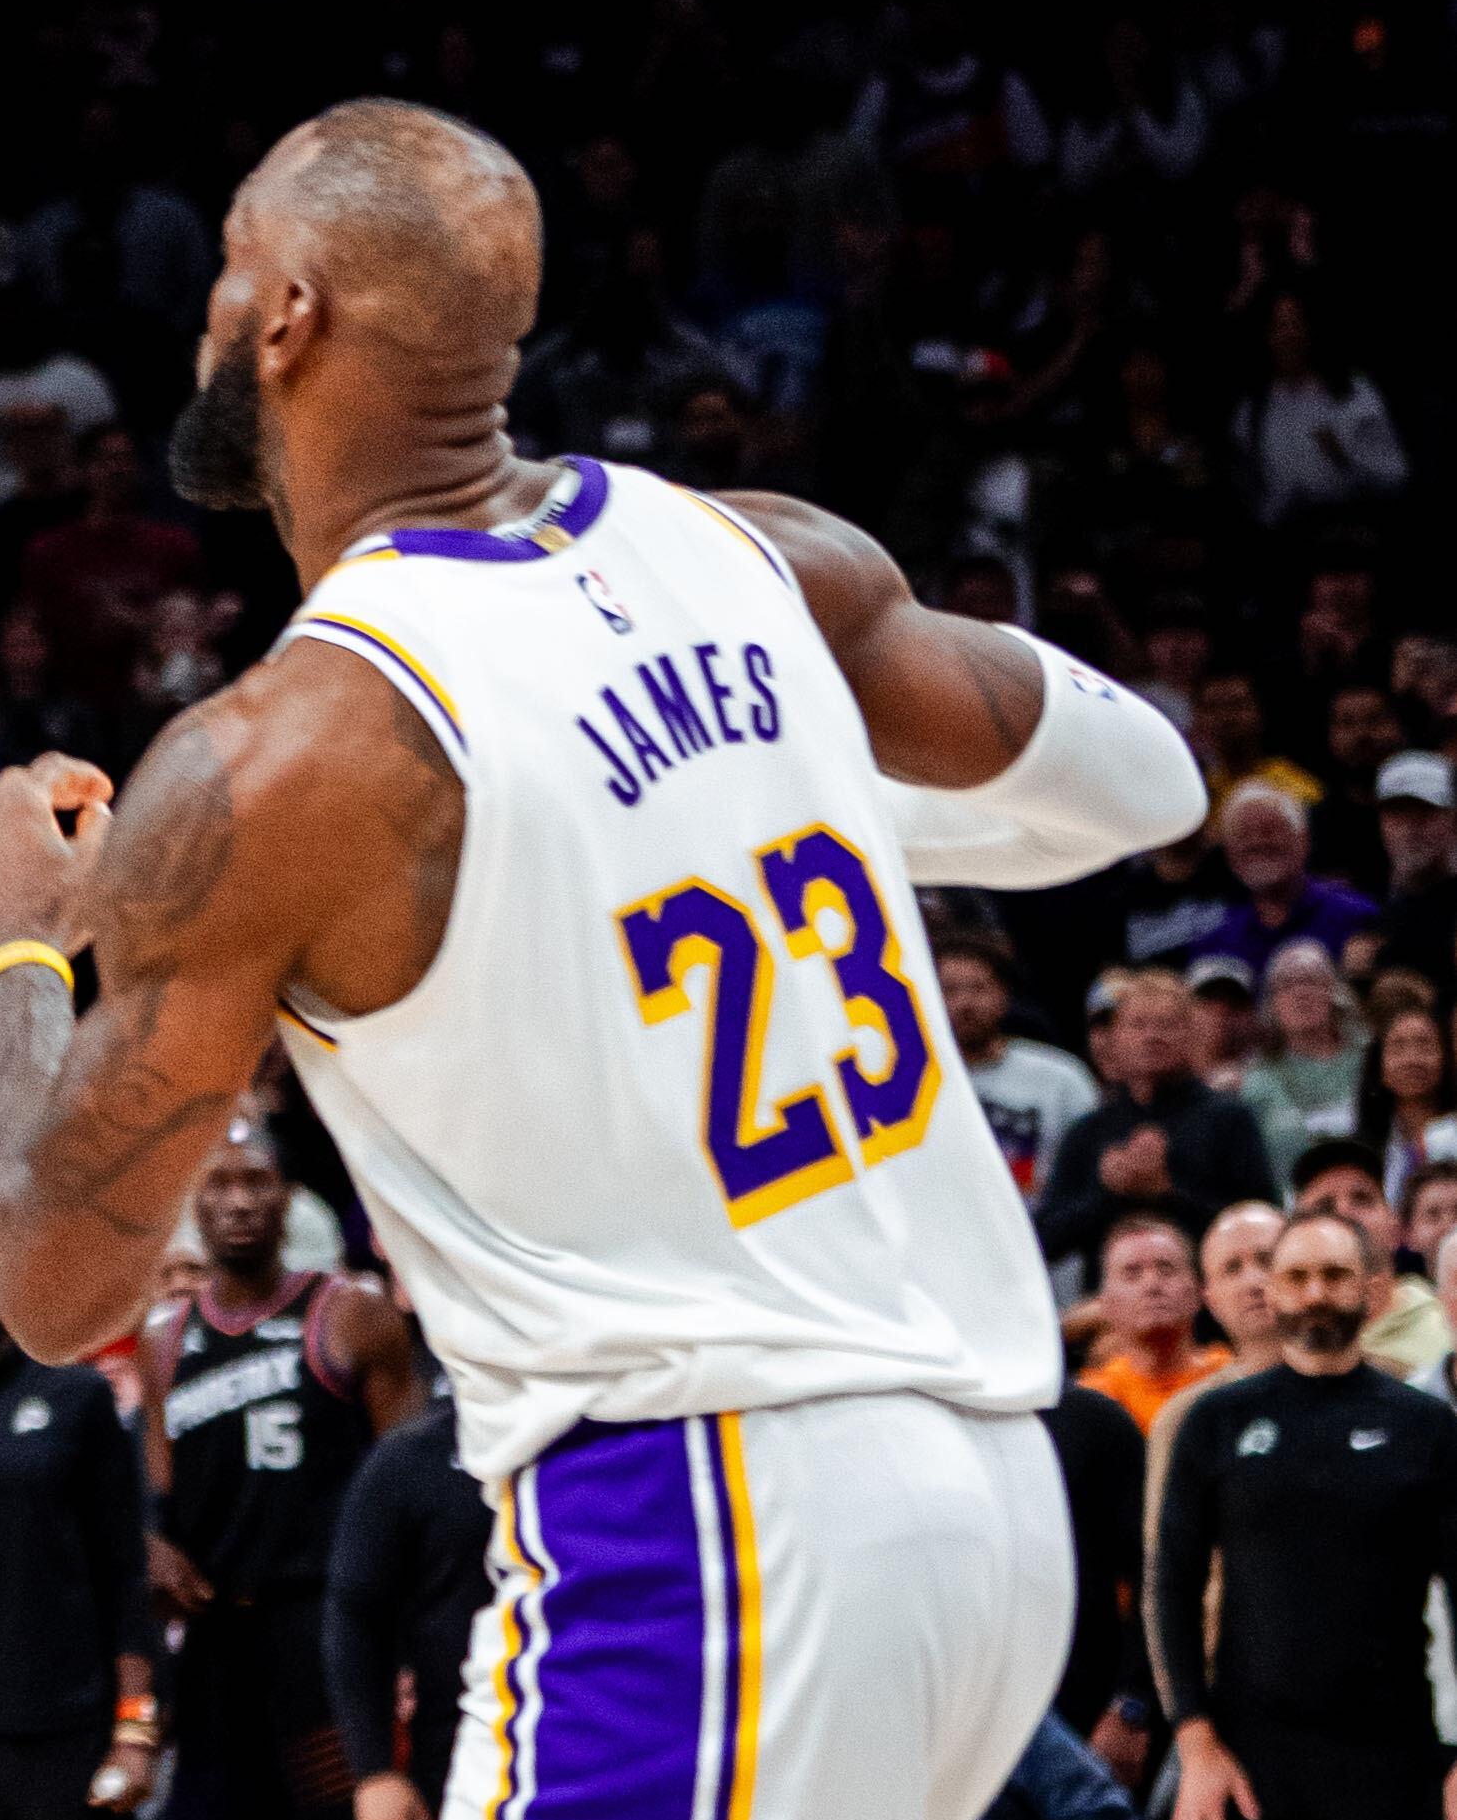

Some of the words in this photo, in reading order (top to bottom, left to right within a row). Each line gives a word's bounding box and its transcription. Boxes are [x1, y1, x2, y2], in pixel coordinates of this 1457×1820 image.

[575, 642, 781, 808] JAMES
[614, 821, 942, 1231] 23
[244, 1399, 304, 1470] 15
